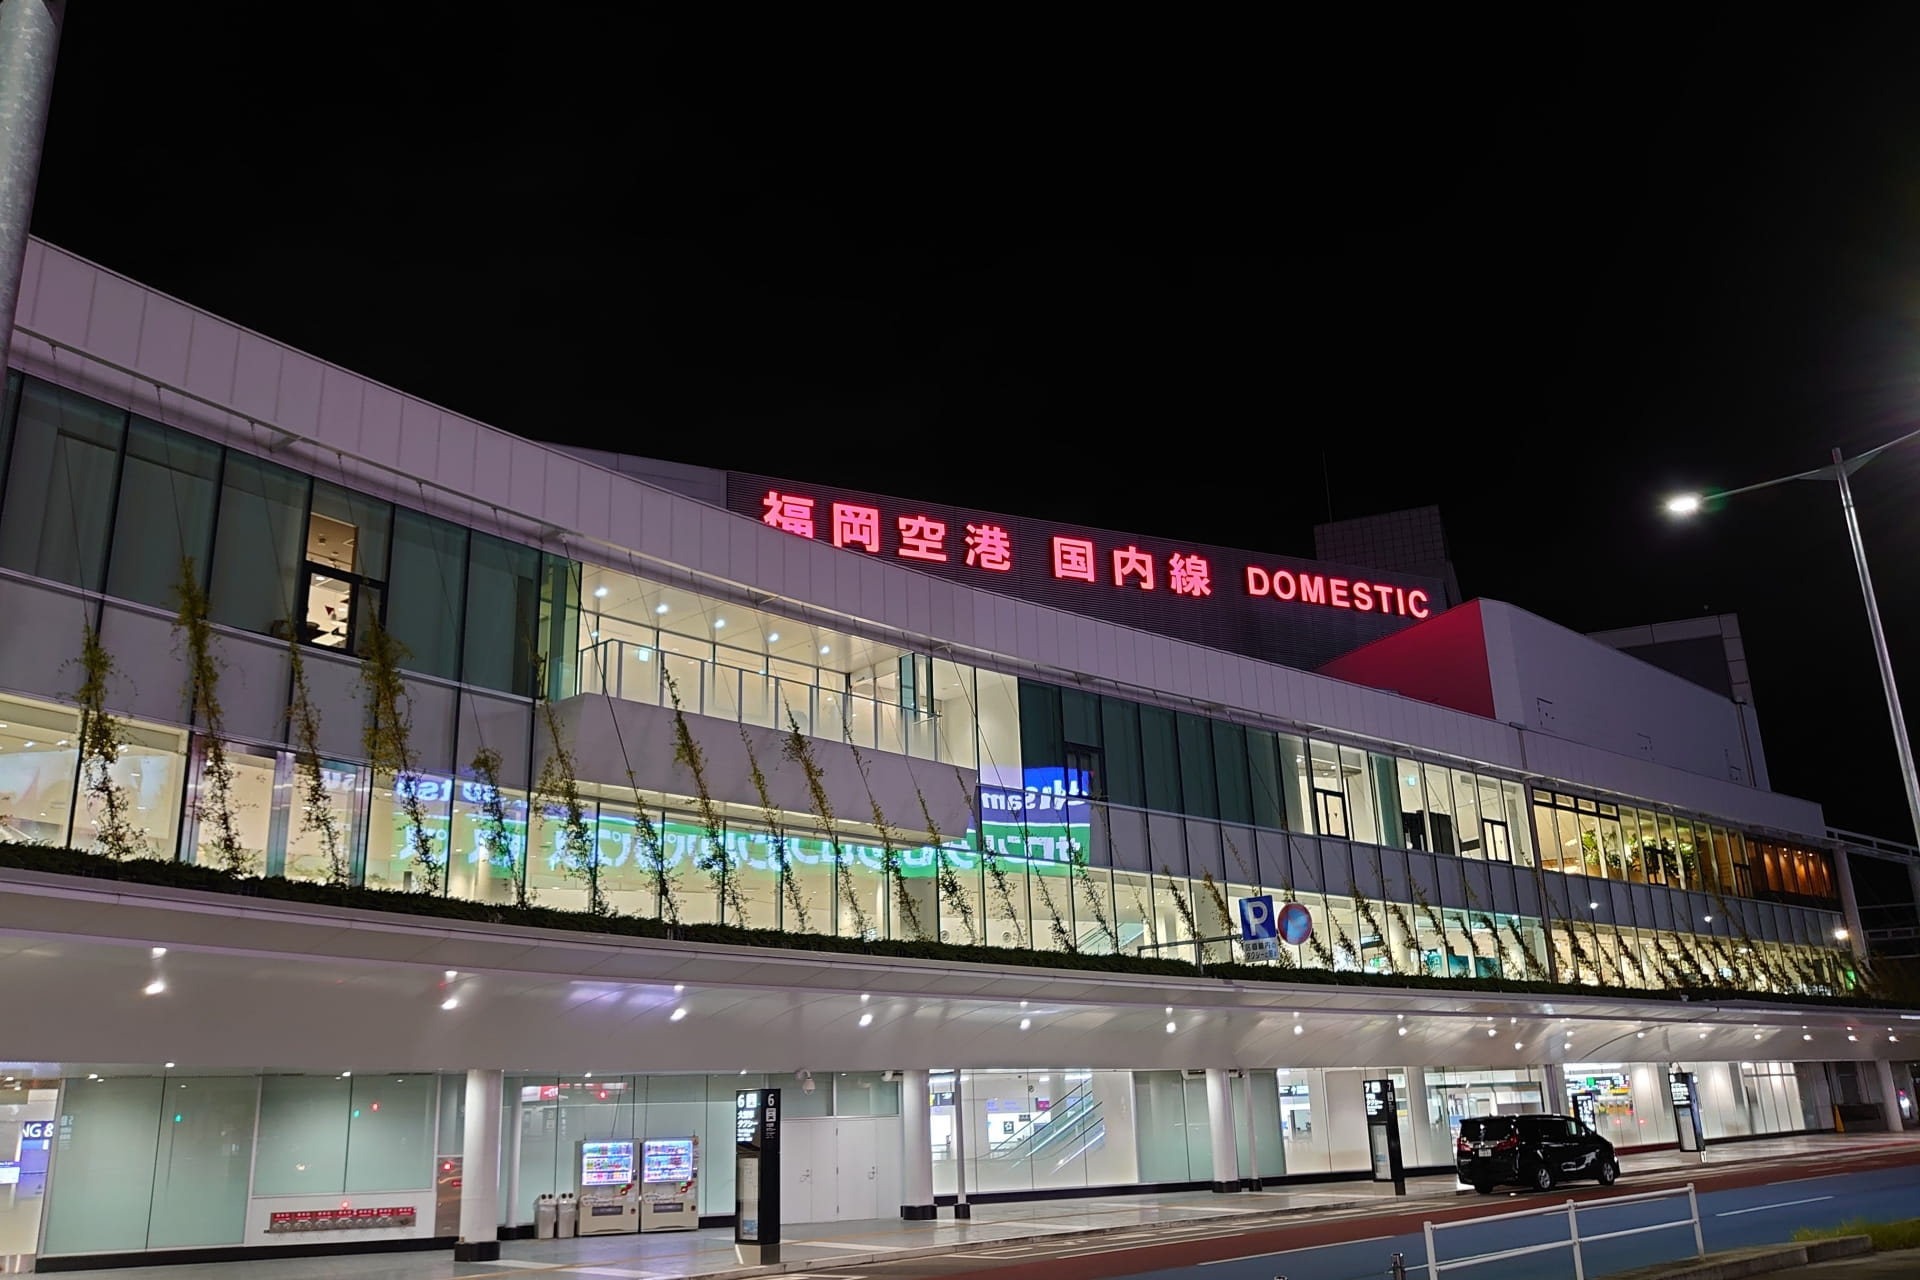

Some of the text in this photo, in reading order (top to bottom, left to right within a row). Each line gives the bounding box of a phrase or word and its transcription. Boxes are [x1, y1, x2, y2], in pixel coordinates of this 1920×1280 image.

[762, 491, 1212, 597] 福岡空港 国内線
[1247, 566, 1429, 619] DOMESTIC
[1247, 901, 1268, 936] P
[737, 1094, 745, 1108] 6
[768, 1093, 775, 1106] 6
